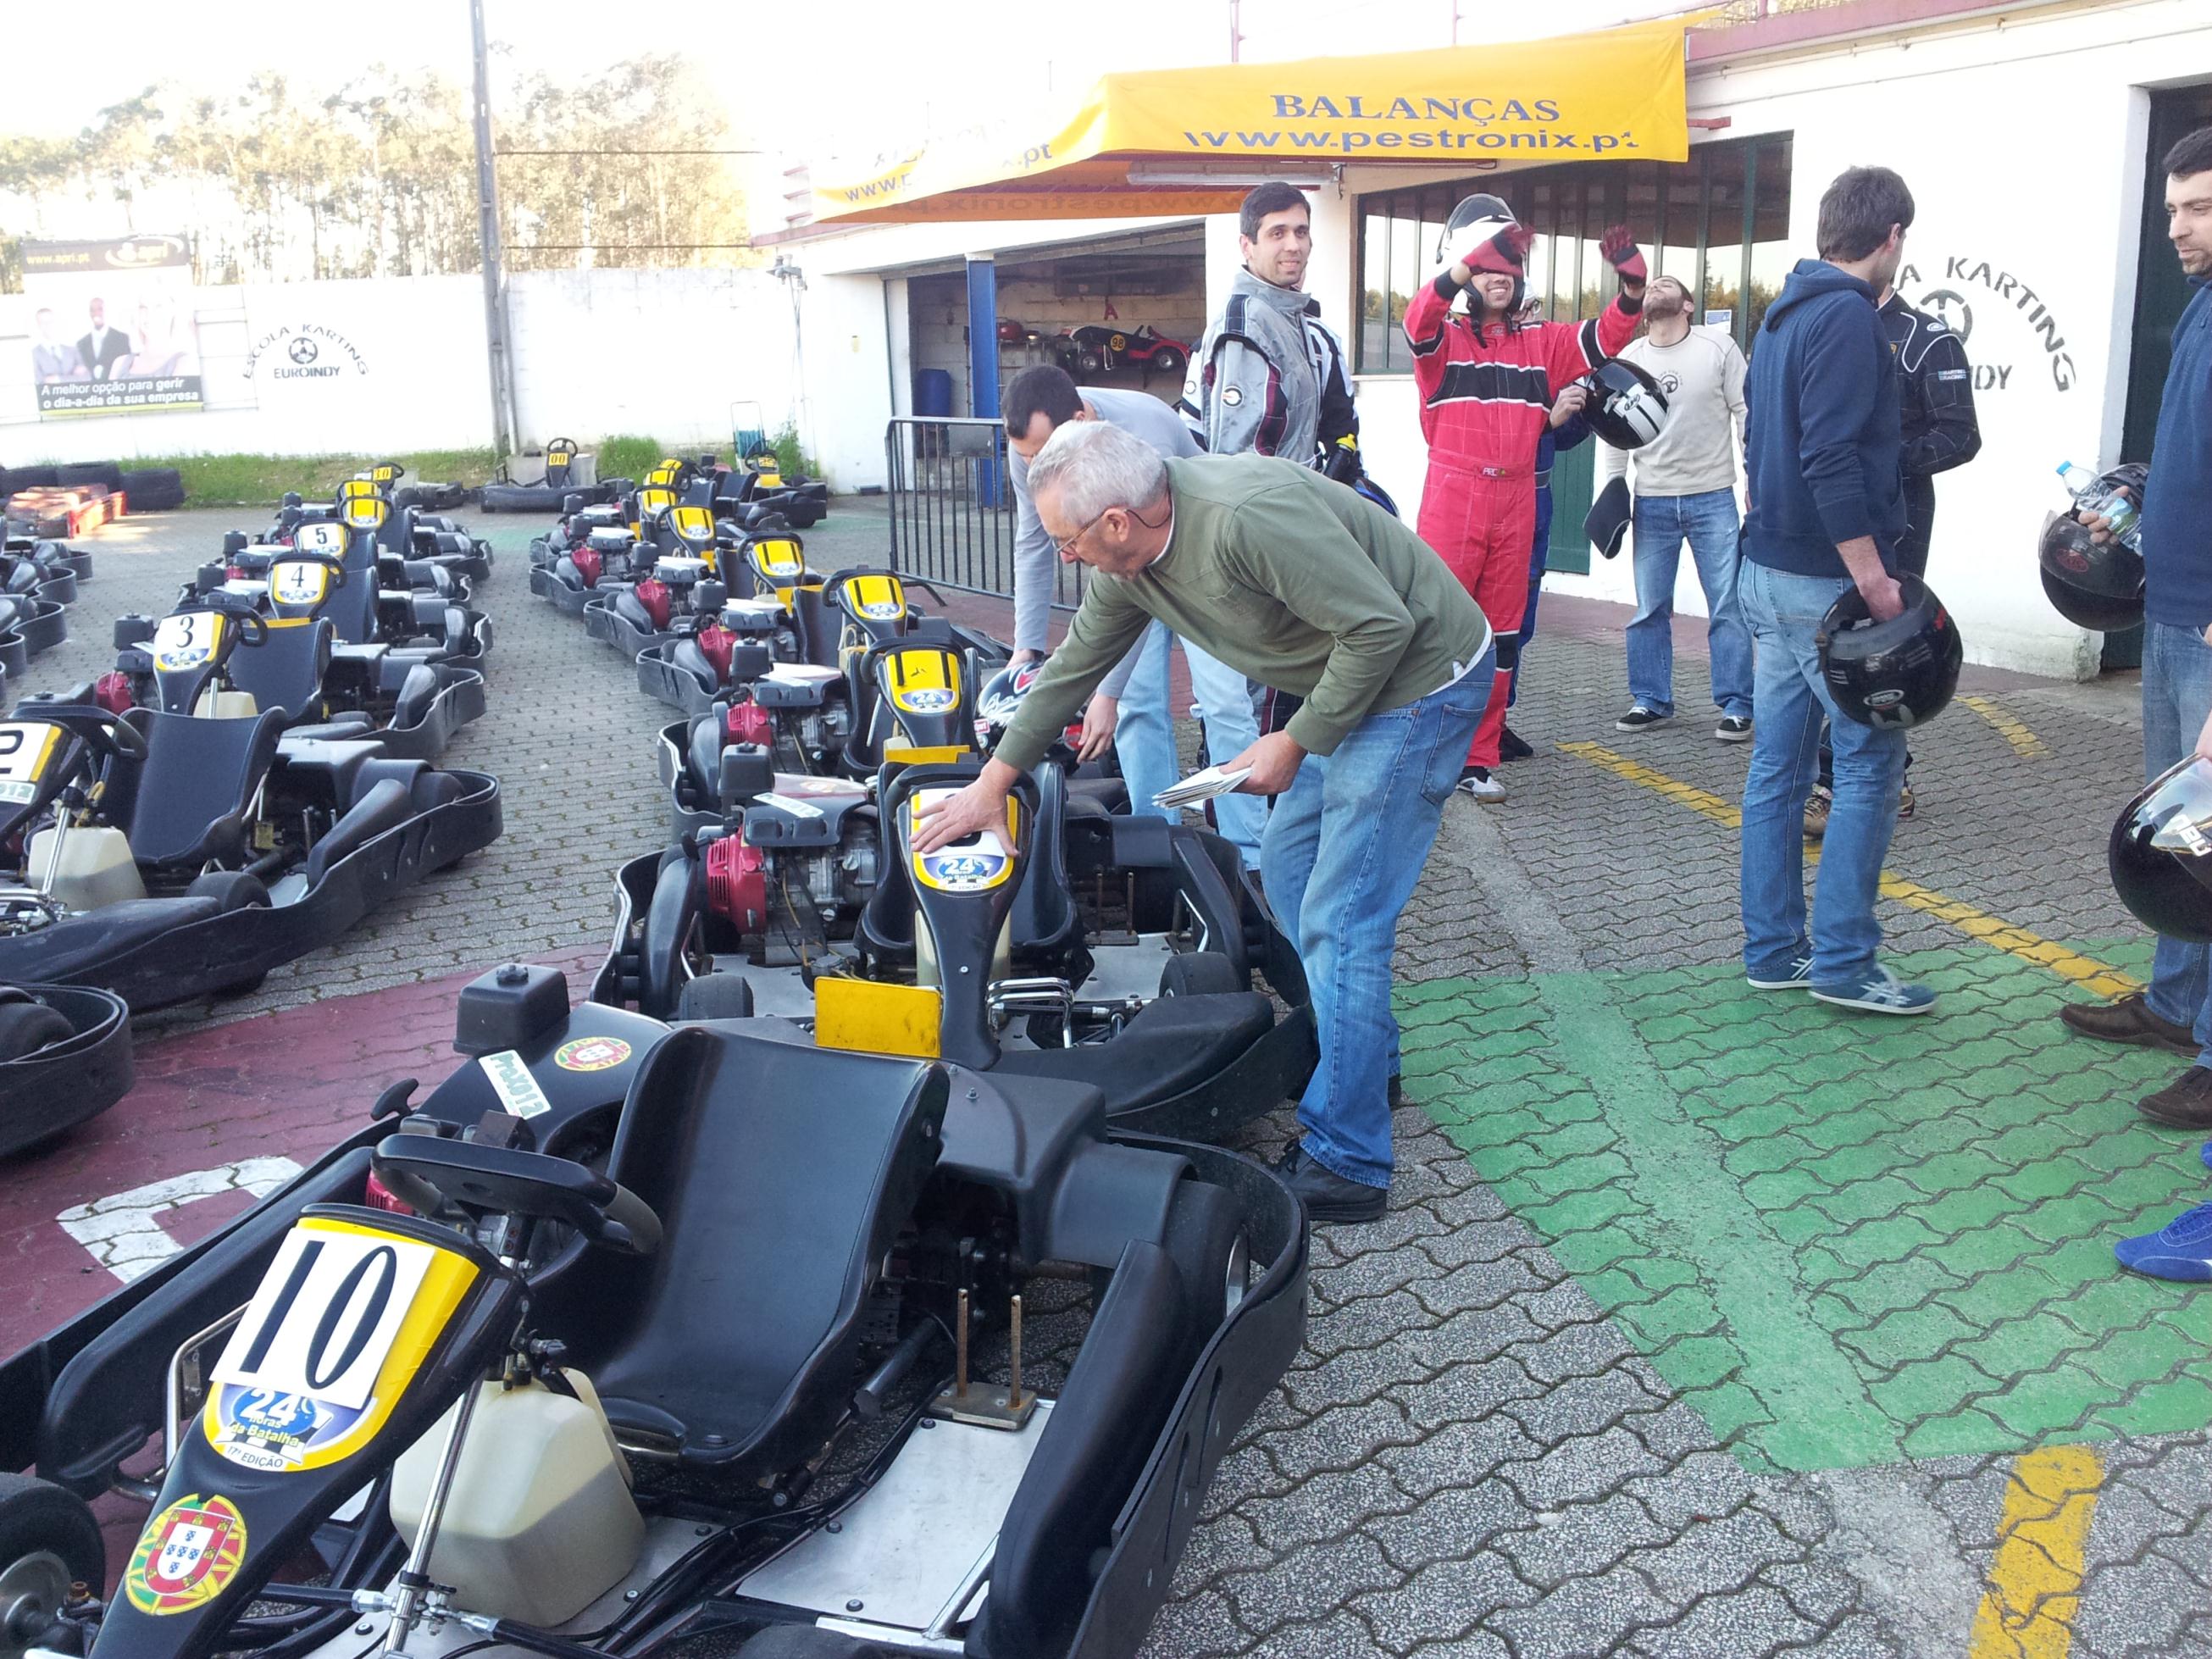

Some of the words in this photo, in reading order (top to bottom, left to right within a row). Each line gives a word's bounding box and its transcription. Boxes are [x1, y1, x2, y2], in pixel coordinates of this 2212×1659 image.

[1271, 94, 1561, 126] BALANÇAS
[1946, 256, 2076, 392] KARTING
[242, 326, 291, 380] ESCOLA
[302, 324, 369, 375] KARTING
[274, 366, 341, 379] EUROINDY
[42, 385, 50, 396] A
[53, 383, 90, 395] melhor
[92, 381, 125, 397] opção
[129, 380, 153, 393] para
[156, 377, 185, 391] gerir
[43, 400, 52, 408] o
[54, 396, 103, 408] dia-a-dia
[107, 394, 121, 405] da
[124, 394, 145, 404] sua
[148, 391, 198, 403] empresa
[551, 453, 566, 464] 00
[315, 527, 328, 545] 5
[291, 565, 305, 588] 4
[175, 615, 195, 649] 3
[944, 857, 976, 874] 24
[238, 1240, 397, 1390] 10
[240, 1387, 297, 1426] 24
[230, 1421, 244, 1434] da
[247, 1422, 300, 1448] Batalha
[241, 1451, 284, 1469] EDIÇÃO
